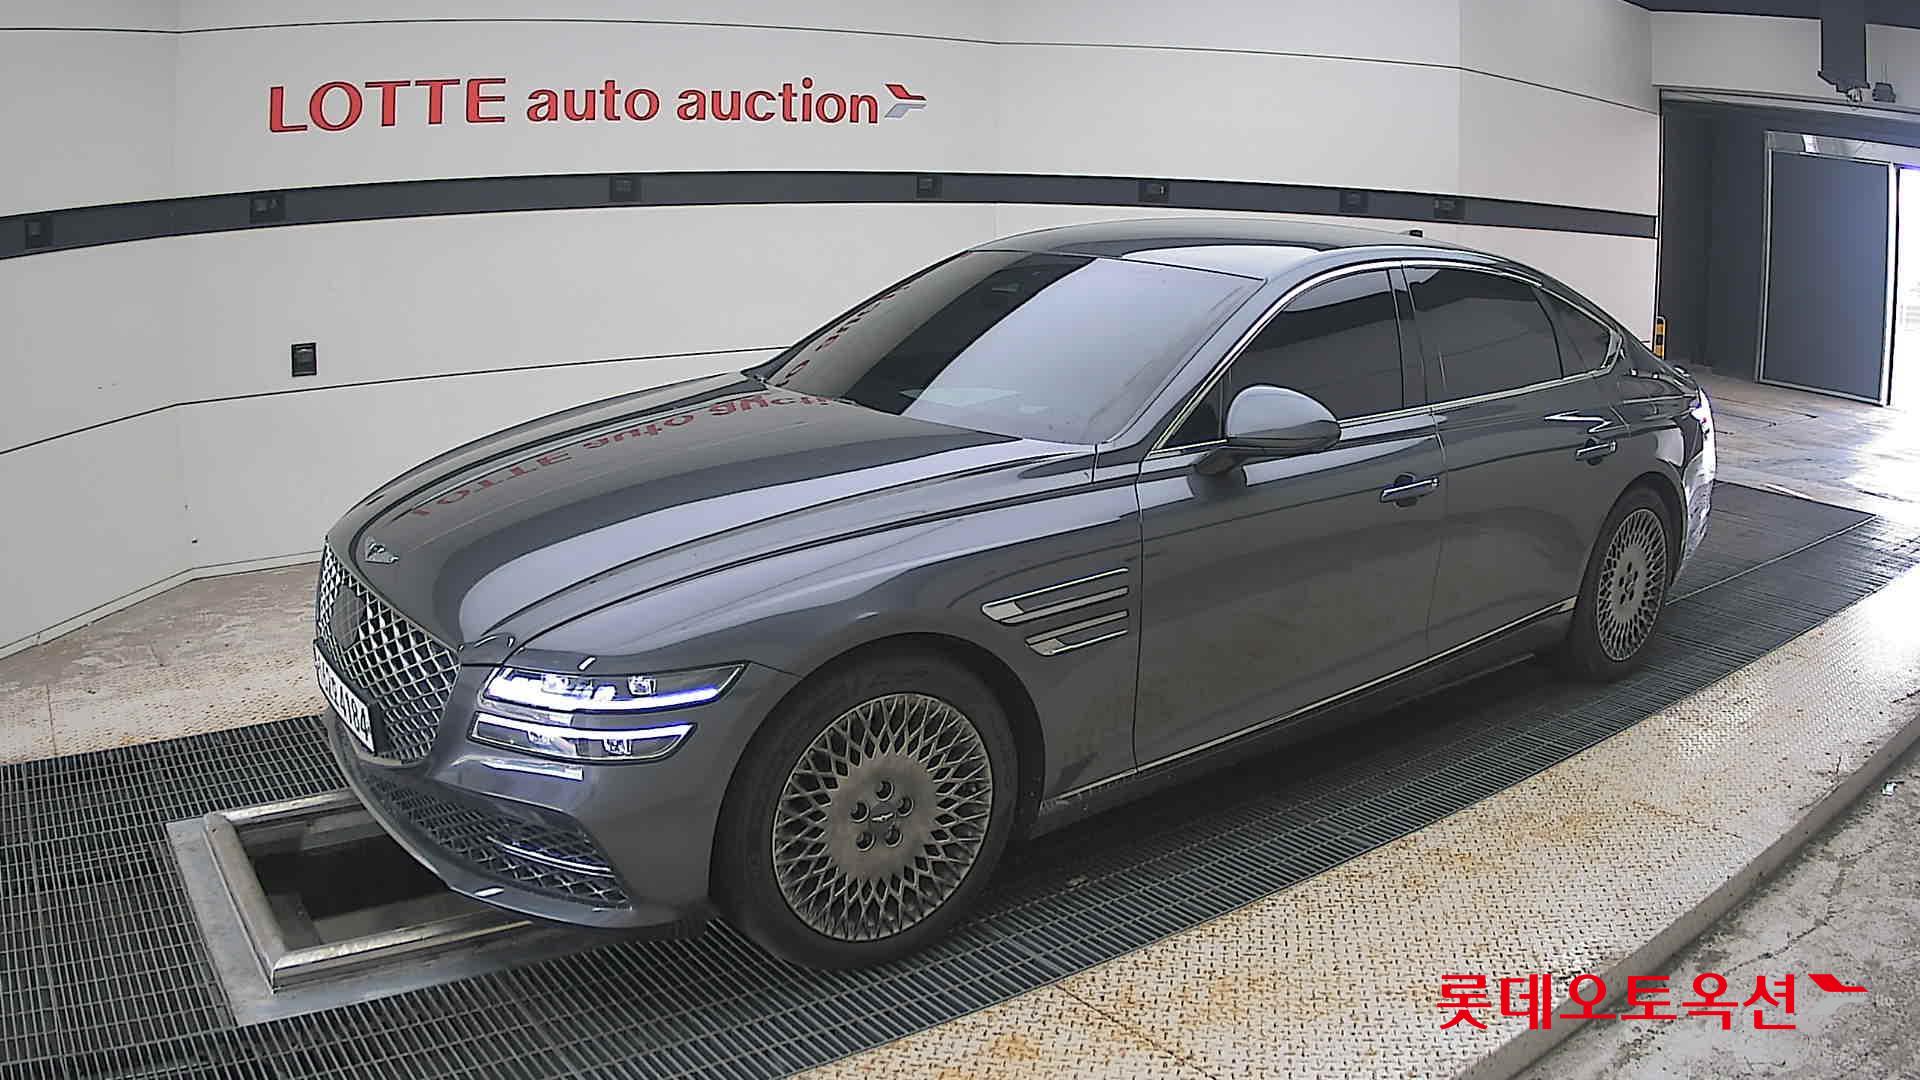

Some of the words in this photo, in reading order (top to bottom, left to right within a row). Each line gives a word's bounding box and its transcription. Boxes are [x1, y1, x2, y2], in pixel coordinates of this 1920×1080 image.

[270, 78, 505, 133] LOTTE
[527, 80, 660, 122] auto
[677, 78, 878, 124] auction
